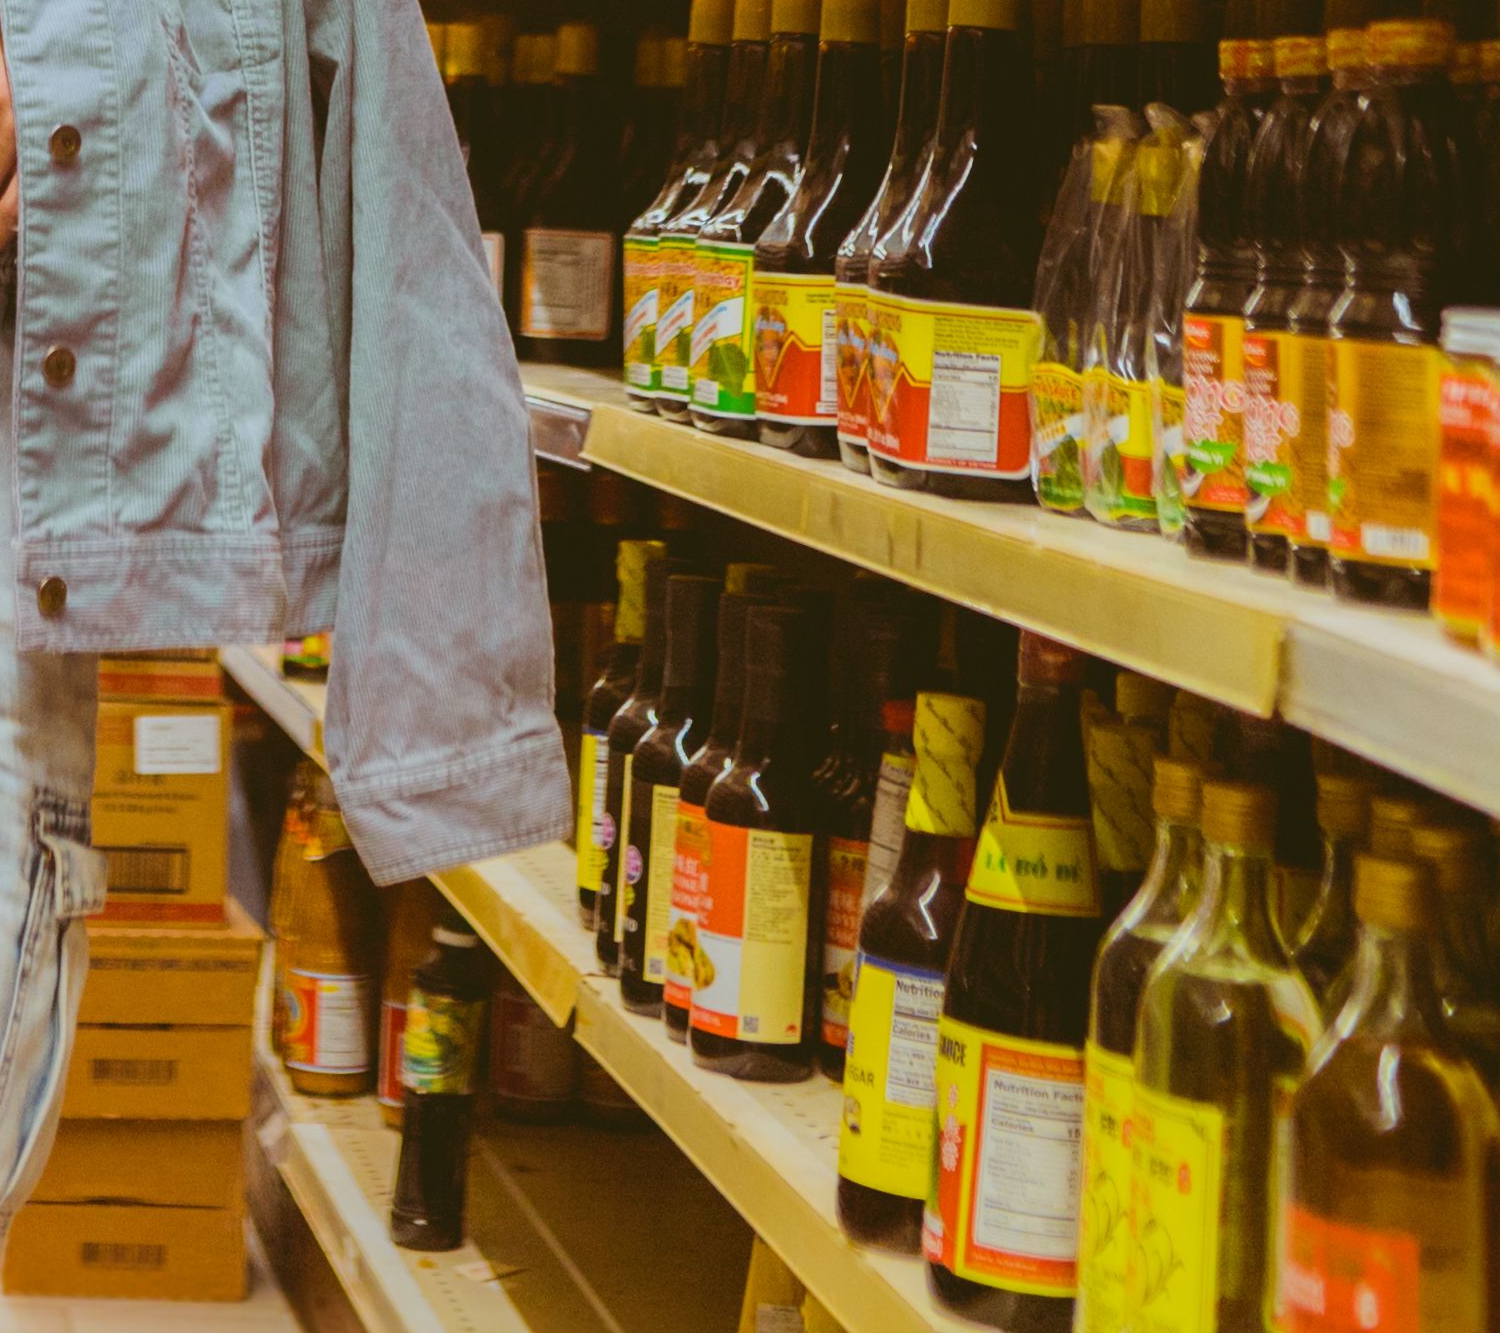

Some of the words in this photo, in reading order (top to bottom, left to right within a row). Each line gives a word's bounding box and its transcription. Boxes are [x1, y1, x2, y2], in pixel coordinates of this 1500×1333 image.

[933, 349, 974, 361] Nutrition
[975, 353, 1000, 363] Facts
[892, 1023, 932, 1041] Calories
[994, 1079, 1050, 1101] Nutrition
[991, 1117, 1035, 1134] Calories
